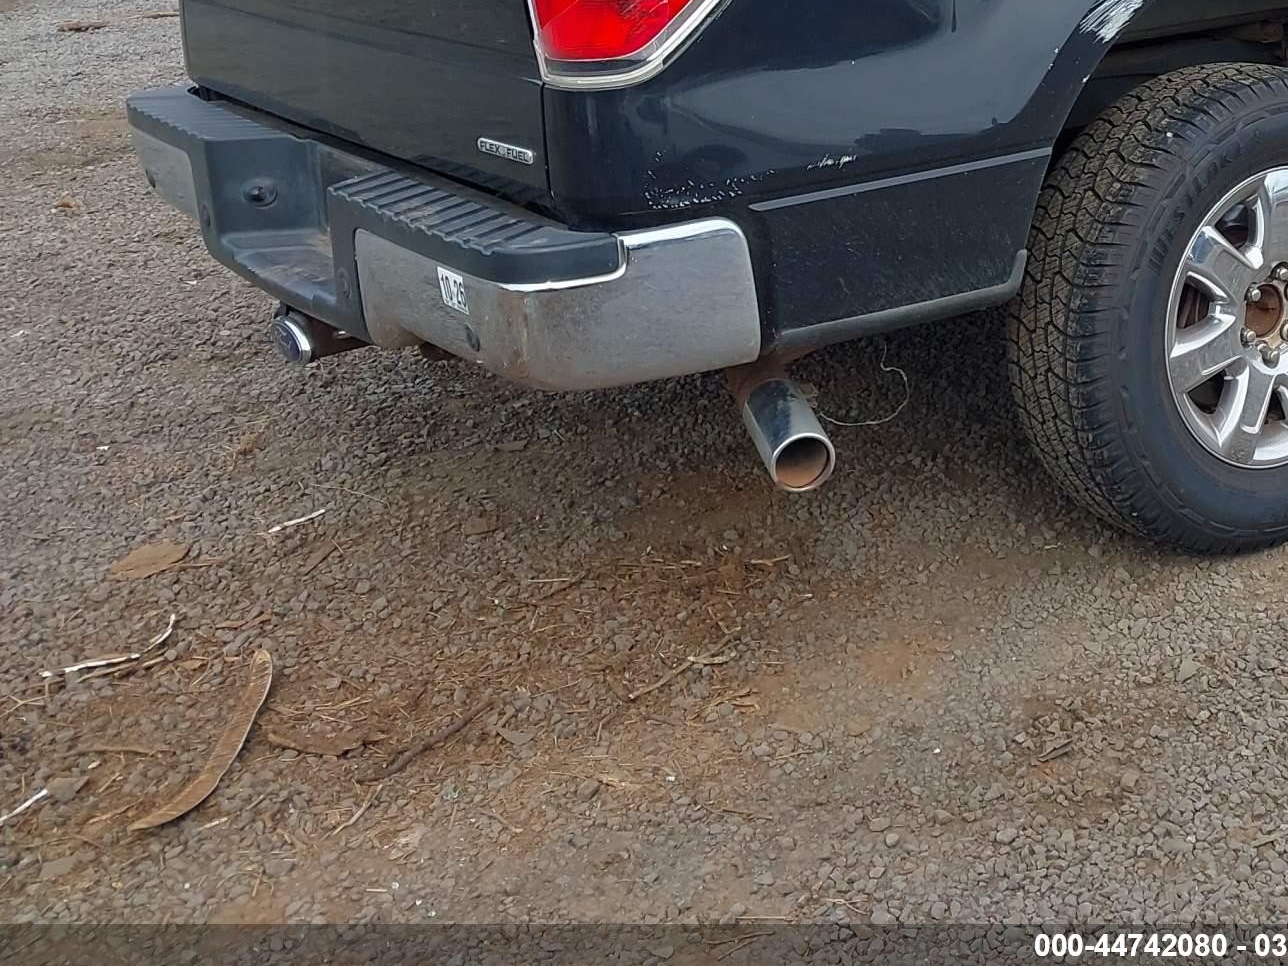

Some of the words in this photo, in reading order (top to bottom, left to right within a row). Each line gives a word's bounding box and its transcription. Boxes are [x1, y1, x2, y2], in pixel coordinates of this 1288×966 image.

[480, 140, 500, 154] FLEX
[506, 147, 531, 162] FUEL
[441, 274, 453, 301] 10
[454, 279, 468, 308] 26
